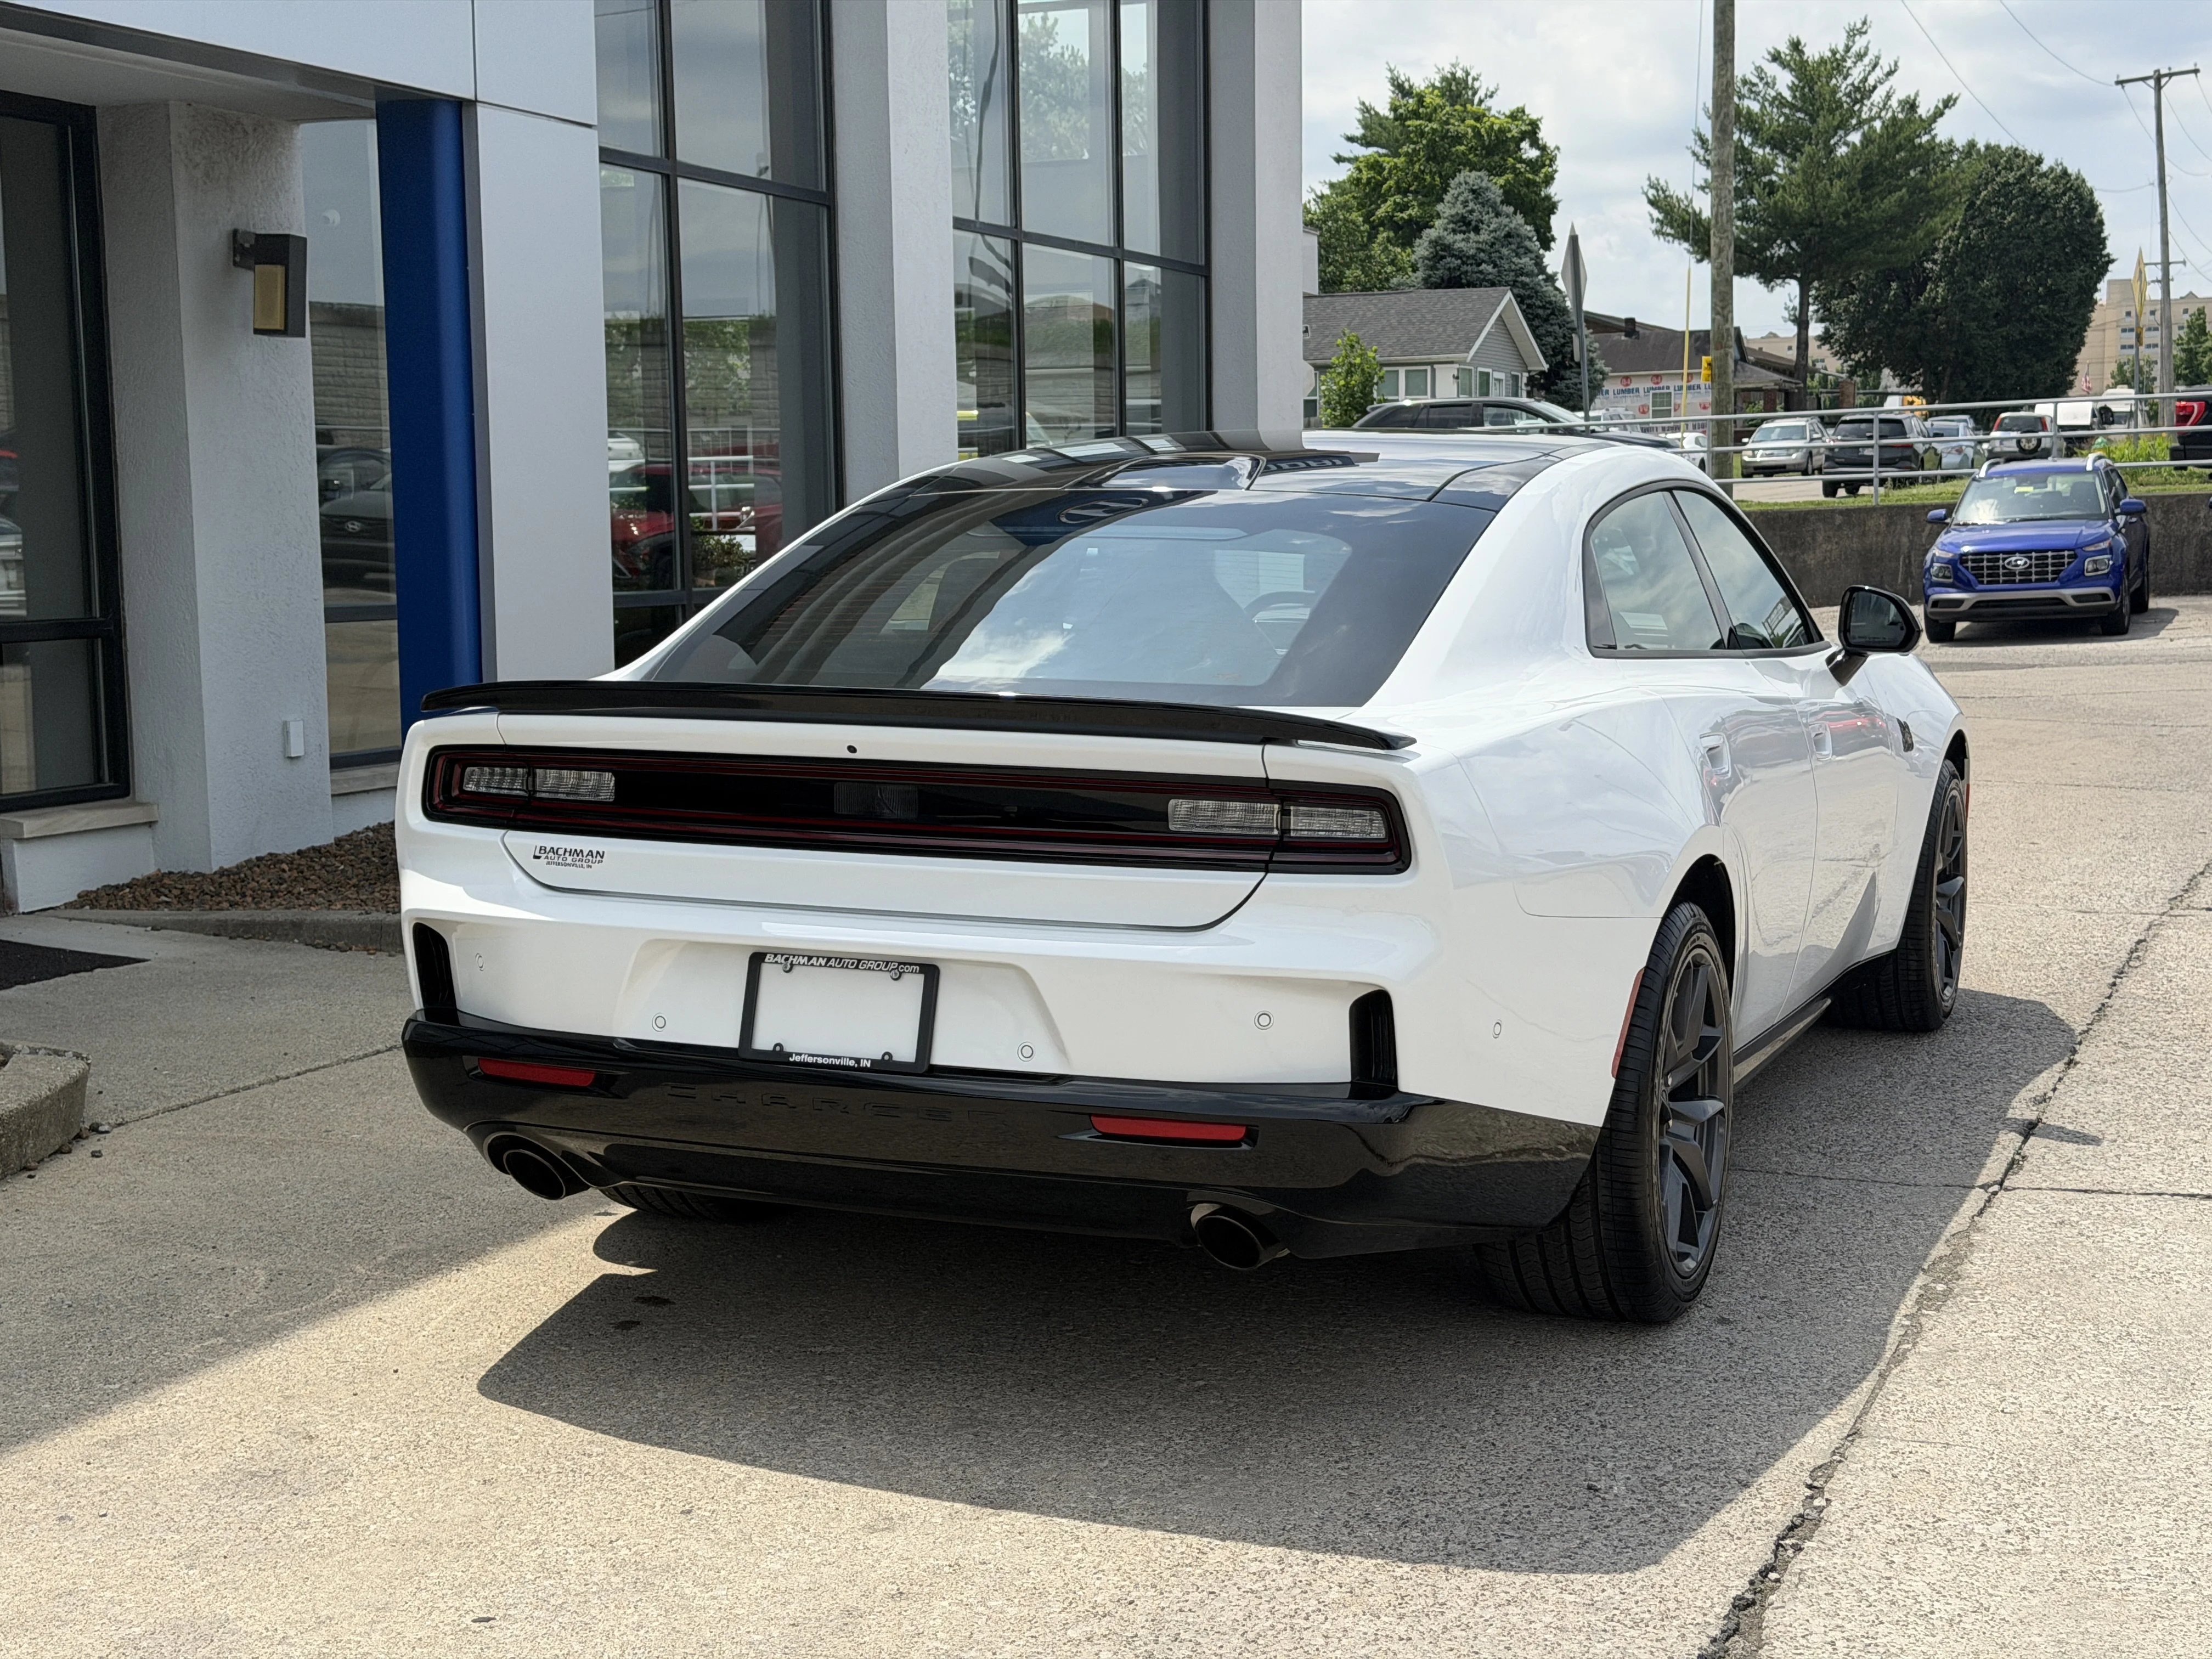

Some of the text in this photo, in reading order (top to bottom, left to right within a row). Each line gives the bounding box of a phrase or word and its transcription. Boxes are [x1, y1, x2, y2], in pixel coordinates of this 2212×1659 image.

[539, 845, 605, 859] BACHMAN
[764, 953, 826, 966] BACHMAN
[827, 959, 857, 969] AUTO
[789, 1053, 871, 1068] Jeffersonville, IN
